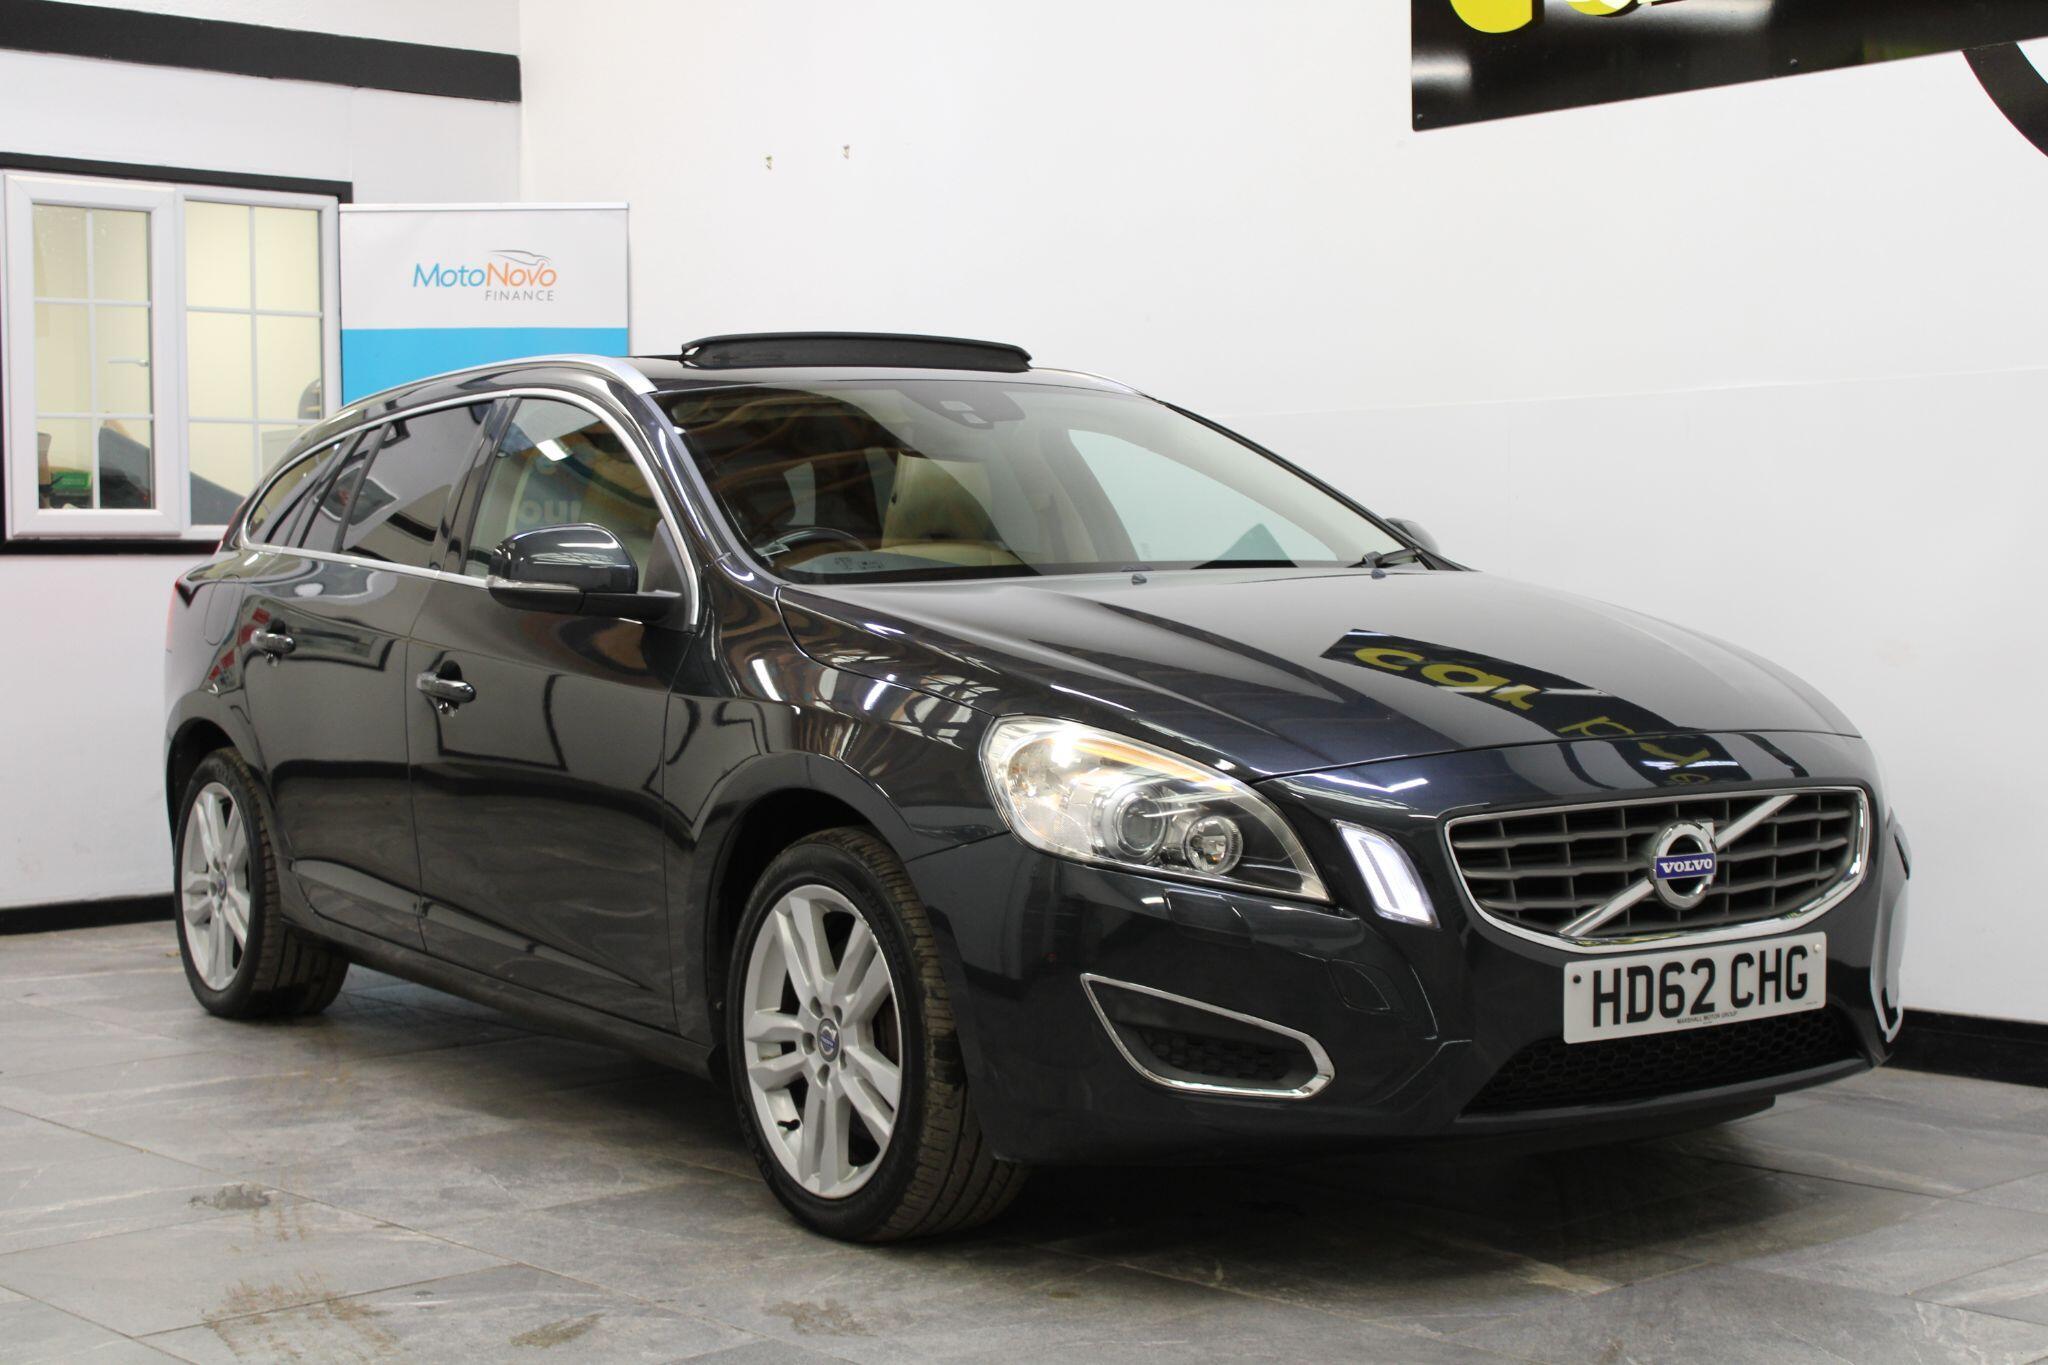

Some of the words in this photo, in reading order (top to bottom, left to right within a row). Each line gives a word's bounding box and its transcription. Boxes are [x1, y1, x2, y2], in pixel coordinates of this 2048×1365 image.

[413, 262, 557, 287] MotoNovo
[485, 290, 554, 301] FINANCE
[1660, 858, 1713, 874] VOLVO
[1593, 957, 1716, 1028] HD62
[1731, 945, 1808, 1009] CHG
